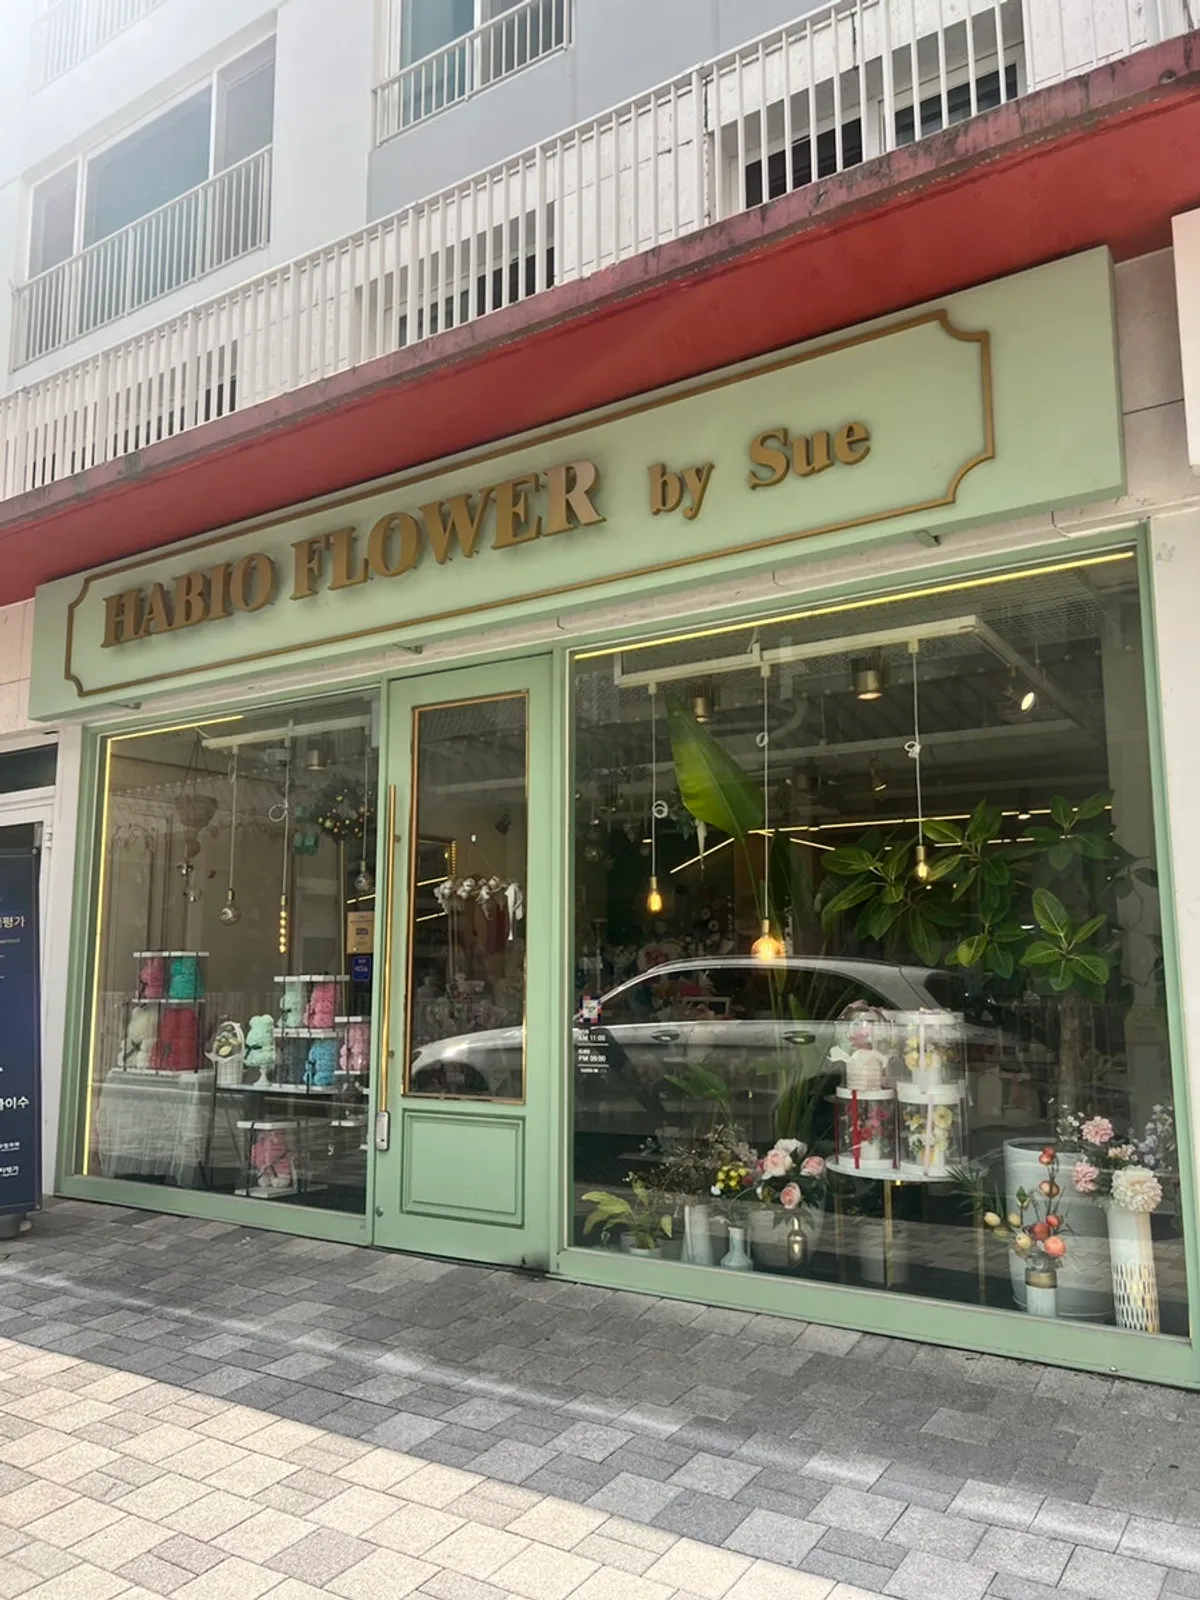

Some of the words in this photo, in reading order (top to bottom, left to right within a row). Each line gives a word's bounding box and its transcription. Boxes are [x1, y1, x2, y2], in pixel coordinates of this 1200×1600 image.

[100, 552, 278, 648] HABIO
[289, 459, 606, 600] FLOWER
[648, 462, 714, 520] by
[747, 419, 871, 490] Sue
[0, 915, 25, 928] 평가
